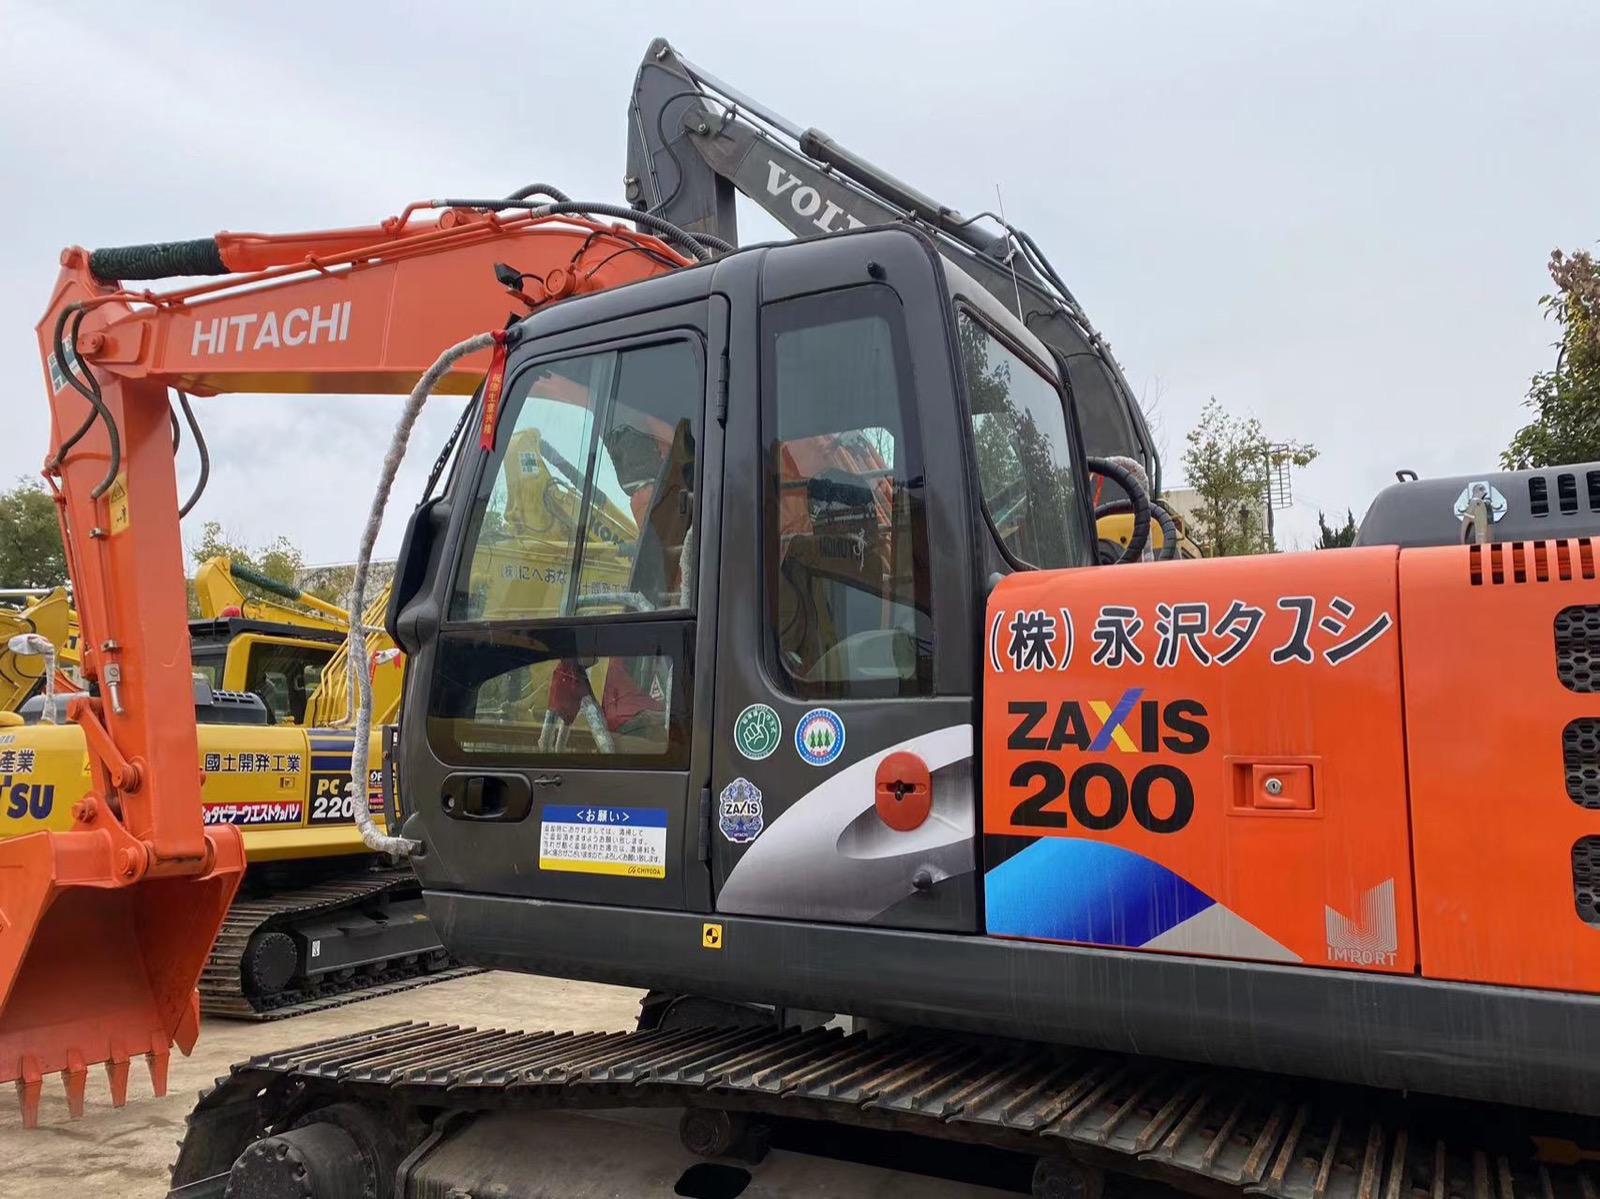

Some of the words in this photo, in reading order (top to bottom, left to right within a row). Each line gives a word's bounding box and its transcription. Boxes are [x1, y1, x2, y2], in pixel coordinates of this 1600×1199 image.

[766, 159, 867, 234] VOL
[190, 301, 352, 356] HITACHI
[1007, 687, 1210, 754] ZAXIS
[204, 753, 300, 773] 國土開発工業
[316, 779, 339, 796] PC
[1009, 760, 1195, 834] 200
[312, 796, 354, 818] 220
[726, 801, 758, 815] ZAXIS
[1327, 946, 1397, 967] IMPORT
